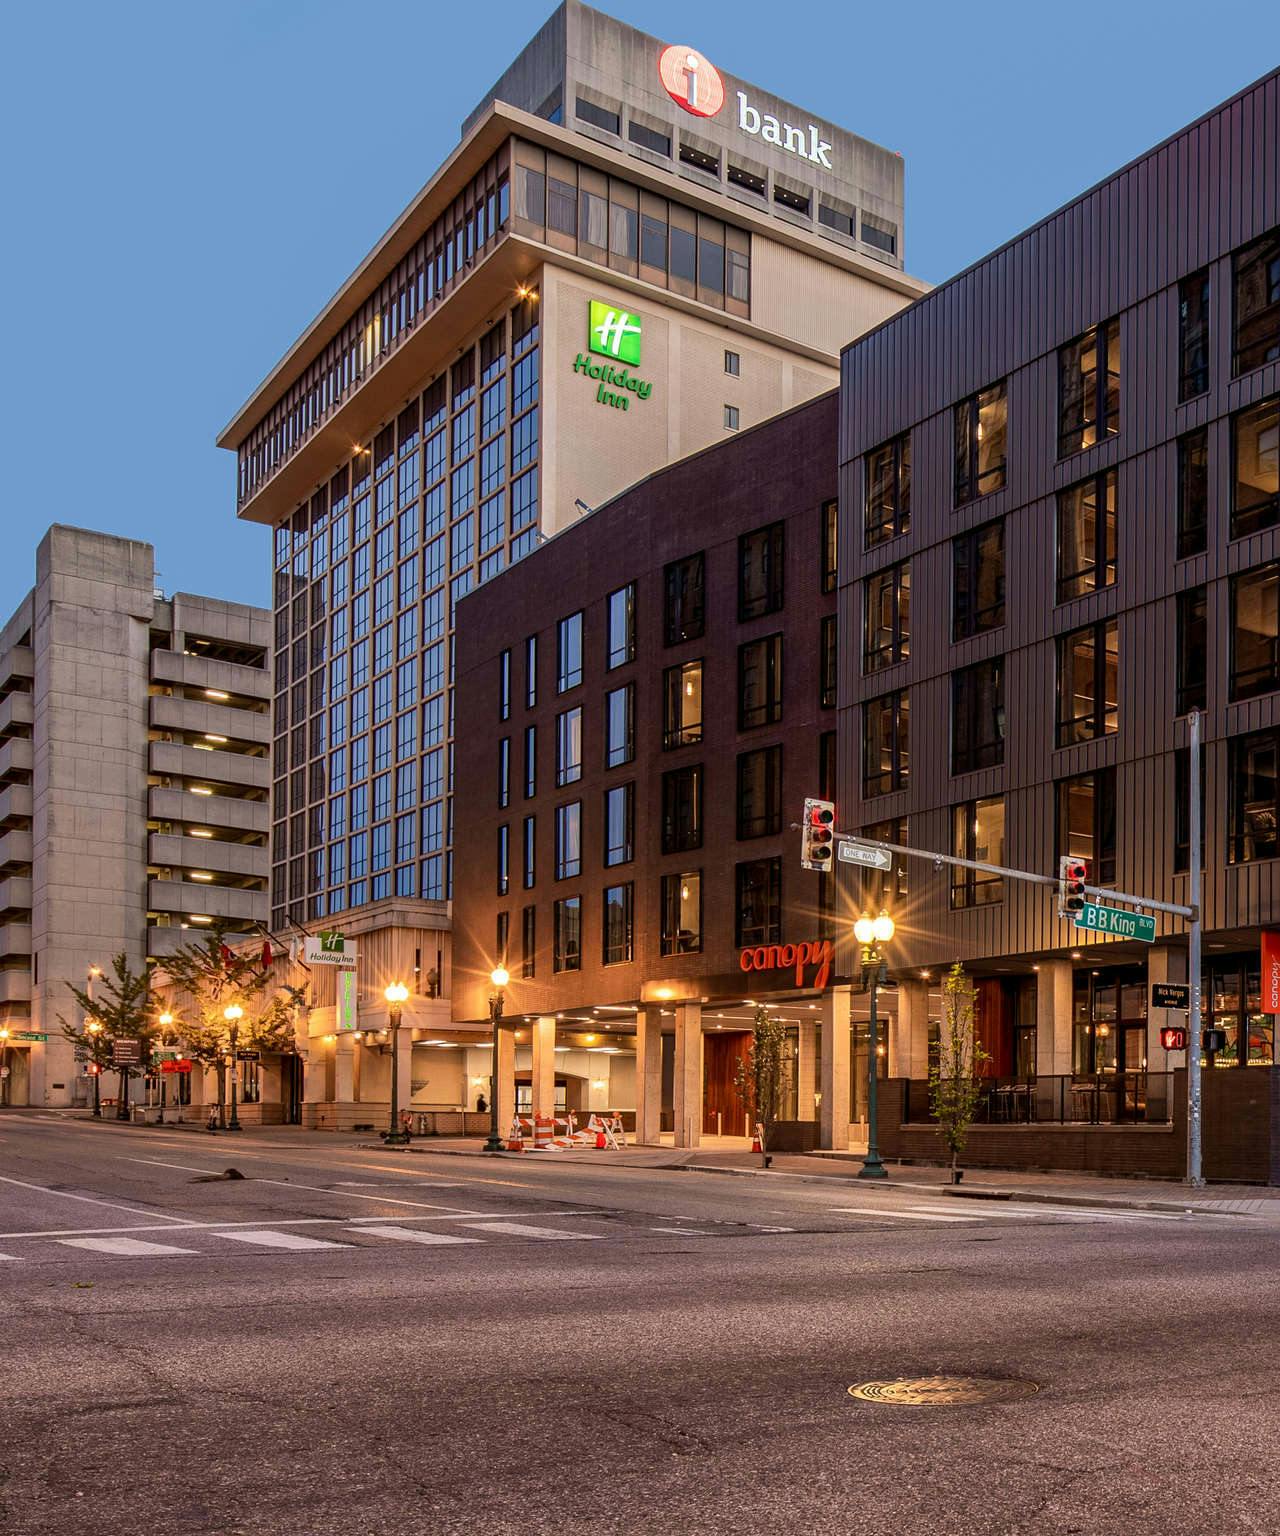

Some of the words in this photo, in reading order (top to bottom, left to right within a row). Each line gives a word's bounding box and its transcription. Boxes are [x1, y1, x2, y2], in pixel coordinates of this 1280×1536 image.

[737, 90, 832, 170] bank
[573, 353, 653, 400] Holiday
[597, 383, 630, 411] Inn
[845, 848, 861, 858] ONE
[862, 852, 877, 860] WAY
[1110, 912, 1136, 936] King
[1139, 918, 1154, 929] BLVD
[310, 952, 341, 963] Holiday
[341, 955, 354, 963] Inn
[741, 940, 835, 990] canopy
